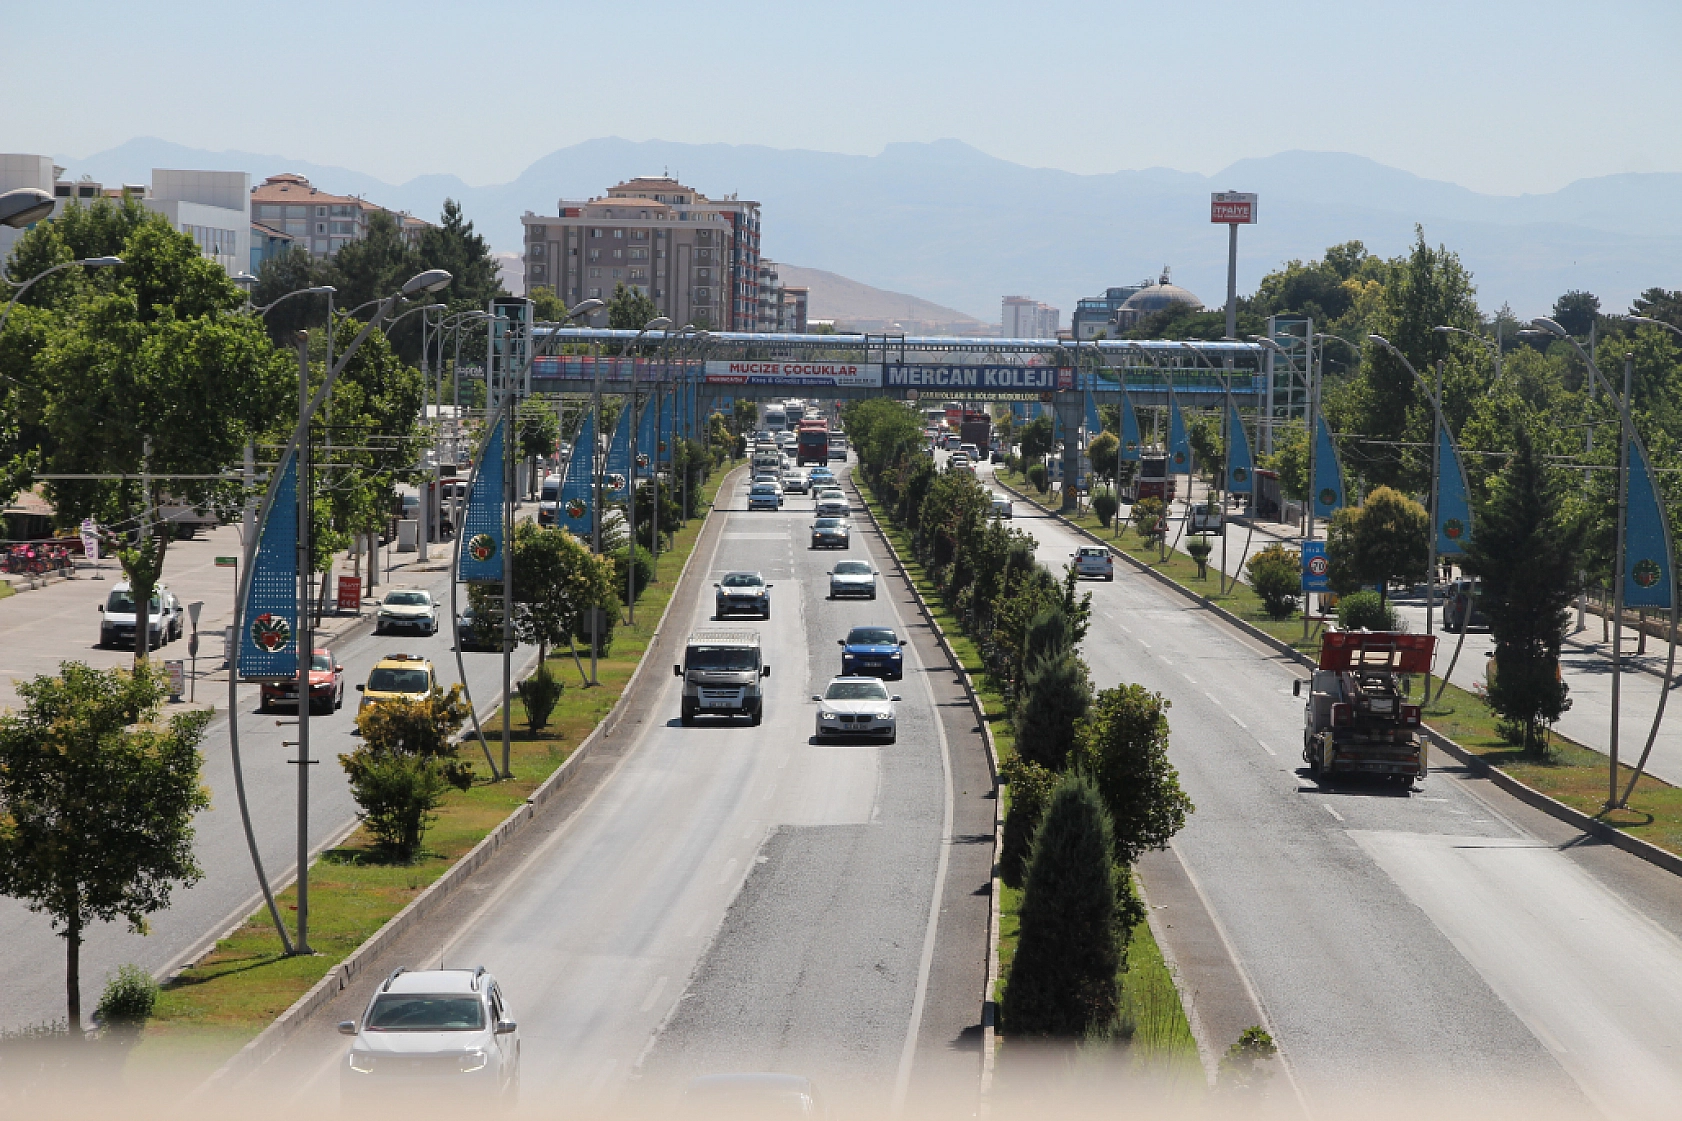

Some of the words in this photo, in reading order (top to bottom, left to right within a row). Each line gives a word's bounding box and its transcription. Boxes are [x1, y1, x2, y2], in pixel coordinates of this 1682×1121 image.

[783, 363, 858, 376] ÇOCUKLAR
[888, 367, 977, 385] MERCAN
[1312, 562, 1325, 571] 70
